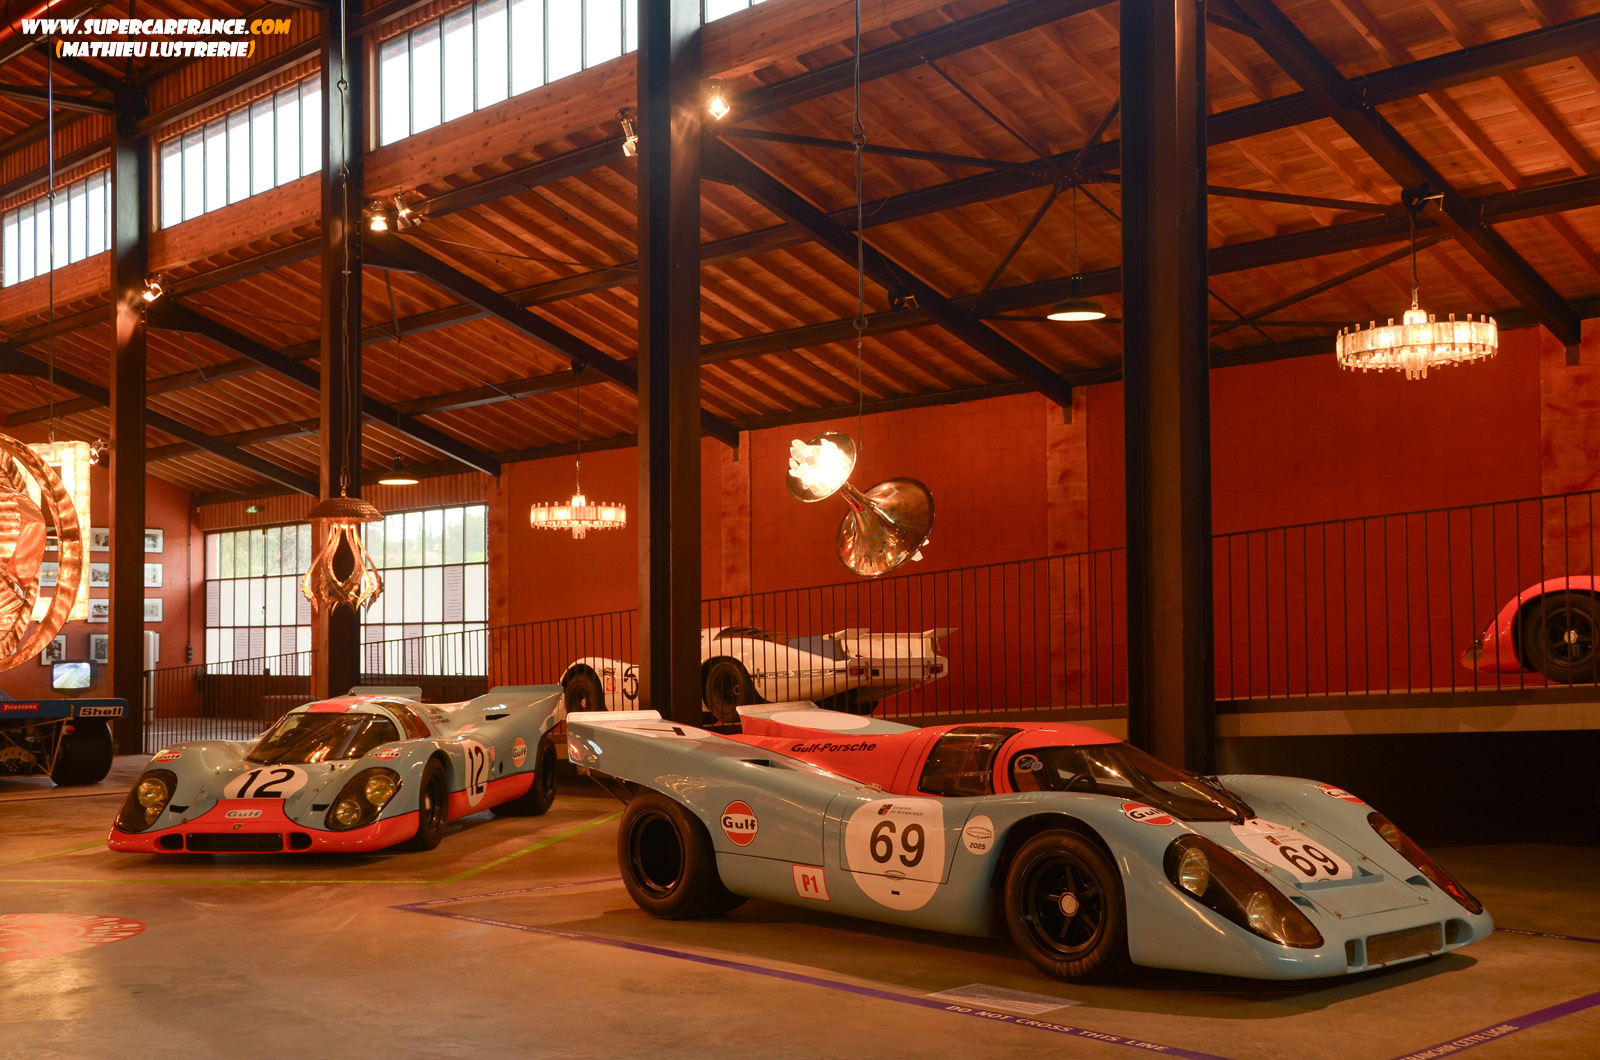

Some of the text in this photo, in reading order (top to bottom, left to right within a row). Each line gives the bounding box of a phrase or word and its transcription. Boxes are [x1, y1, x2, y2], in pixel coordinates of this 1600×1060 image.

[4, 703, 38, 711] Firestone
[81, 707, 123, 716] Shell
[513, 747, 527, 758] Gulf
[791, 742, 877, 753] Gulf-Porsche
[468, 746, 485, 796] 12
[236, 767, 296, 799] 12
[226, 810, 262, 818] Gulf
[722, 816, 756, 831] Gulf
[869, 820, 925, 868] 69
[969, 842, 986, 850] 2025
[1279, 844, 1339, 877] 69
[801, 873, 819, 893] P1
[945, 1005, 1170, 1051] DO NOT CROSS THIS LINE
